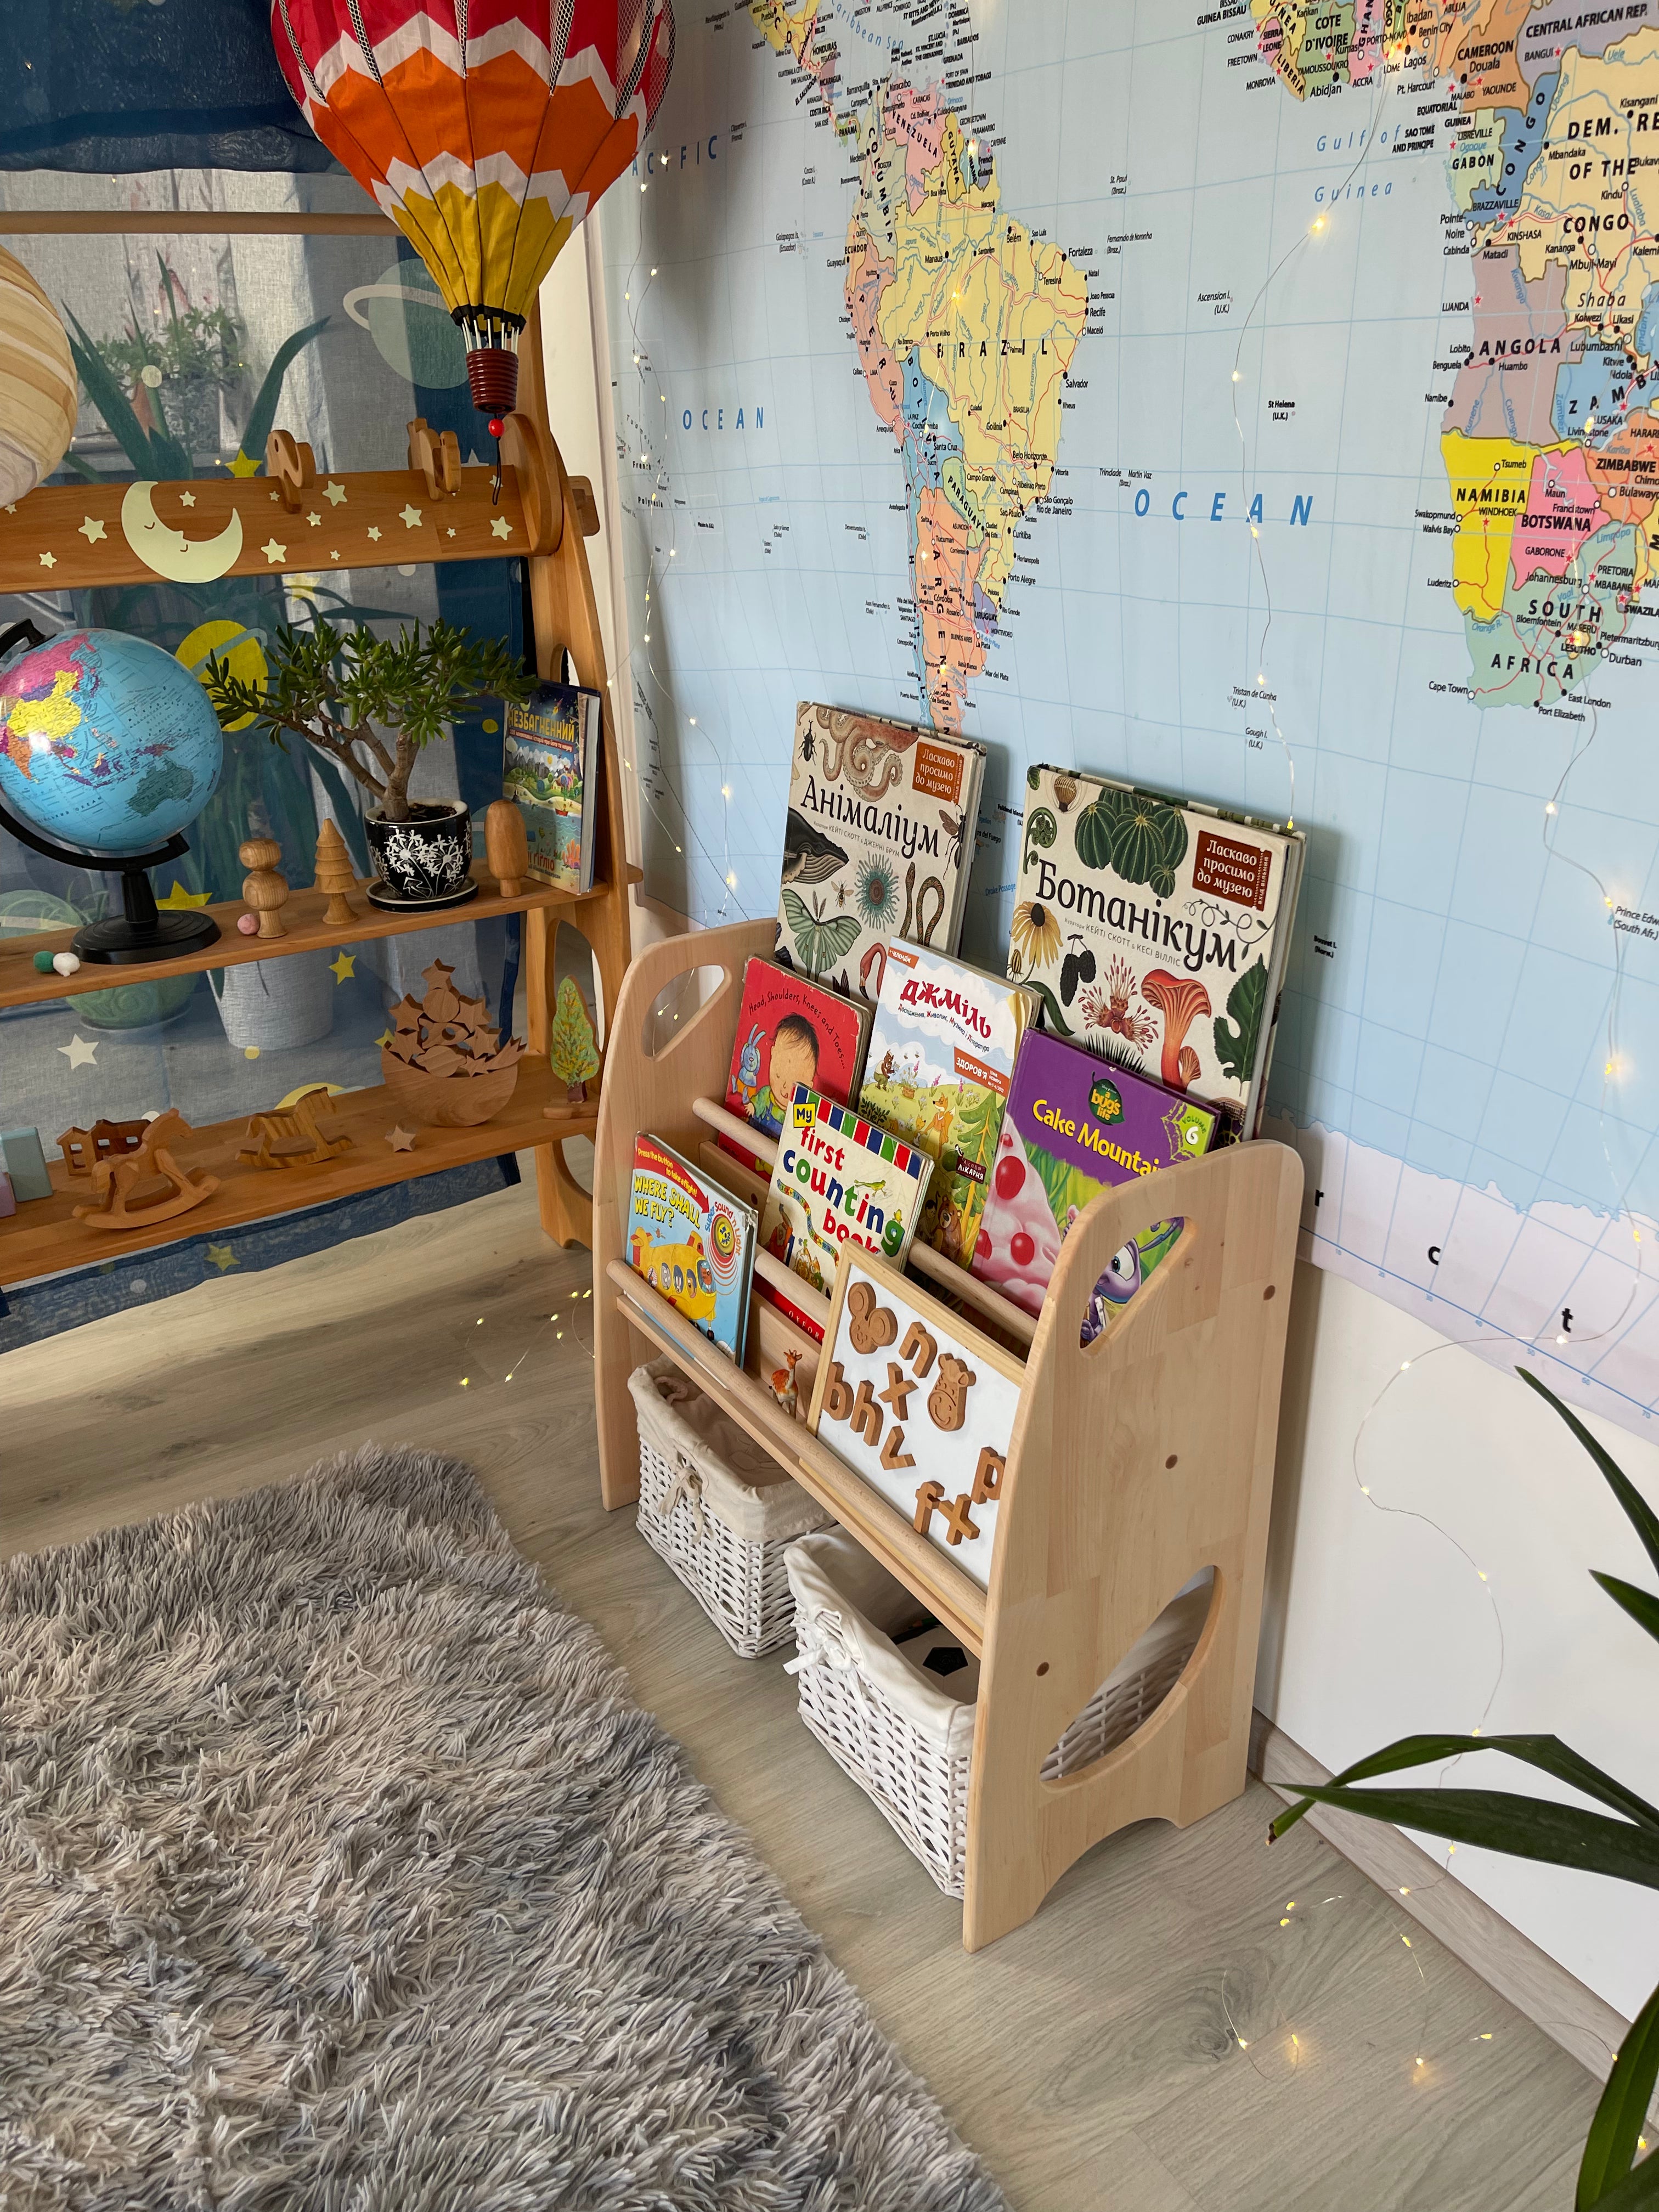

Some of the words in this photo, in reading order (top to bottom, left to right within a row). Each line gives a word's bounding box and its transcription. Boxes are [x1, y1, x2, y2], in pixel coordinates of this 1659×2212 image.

[1197, 12, 1221, 25] GUINEA
[1222, 5, 1246, 19] BISSAU
[1316, 14, 1342, 30] COTE
[1407, 9, 1432, 23] Ibadan
[1526, 18, 1572, 38] CENTRAL
[1575, 8, 1623, 29] AFRICAN
[1626, 3, 1648, 19] REP.
[1227, 30, 1255, 43] CONAKRY
[1263, 28, 1283, 40] SIERRA
[1419, 26, 1438, 37] Benin
[1440, 22, 1453, 34] City
[1263, 41, 1282, 52] LEONE
[1458, 40, 1514, 61] CAMEROON
[1227, 53, 1258, 67] FREETOWN
[1297, 60, 1348, 76] YAMOUSSOUKRO
[1404, 56, 1426, 69] Lagos
[1469, 58, 1500, 72] Douala
[1277, 54, 1304, 95] LIBERIA
[1352, 76, 1373, 88] ACCRA
[1246, 77, 1276, 91] MONROVIA
[1310, 84, 1341, 98] Abidjan
[1417, 101, 1457, 116] EQUATORIAL
[1444, 116, 1471, 128] GUINEA
[893, 111, 938, 157] VENEZUELA
[1316, 129, 1367, 152] Gulf
[1381, 125, 1402, 144] of
[1457, 128, 1493, 140] LIBREVILLE
[1497, 91, 1545, 196] CONGO
[1452, 154, 1494, 170] GABON
[1570, 162, 1592, 180] OF
[1601, 157, 1638, 177] THE
[1314, 182, 1392, 202] Guinea
[1472, 199, 1519, 212] BRAZZAVILLE
[1564, 214, 1629, 234] CONGO
[1507, 230, 1542, 241] KINSHASA
[845, 244, 867, 254] ECUADOR
[1069, 248, 1092, 257] Fortaleza
[1198, 292, 1227, 302] Ascension
[1577, 292, 1626, 307] Shaba
[1090, 308, 1105, 317] Recife
[1442, 302, 1469, 312] LUANDA
[937, 338, 1047, 358] BRAZIL
[1479, 338, 1560, 356] ANGOLA
[1570, 341, 1623, 352] Lubumbashi
[1065, 380, 1088, 388] Salvador
[683, 407, 764, 430] OCEAN
[1596, 458, 1656, 473] ZIMBABWE
[947, 475, 981, 529] PARAGUAY
[1457, 488, 1525, 504] NAMIBIA
[1135, 489, 1313, 526] OCEAN
[1479, 507, 1517, 517] WINDHOEK
[1521, 514, 1591, 532] BOTSWANA
[1525, 546, 1565, 557] GABORONE
[1598, 565, 1634, 577] PRETORIA
[1007, 574, 1021, 582] Porto
[1022, 576, 1035, 585] Alegre
[974, 611, 998, 622] URUGUAY
[1528, 599, 1602, 623] SOUTH
[1491, 654, 1573, 680] AFRICA
[1609, 653, 1642, 667] Durban
[1233, 686, 1250, 697] Tristan
[1260, 691, 1277, 701] Cunha
[1429, 681, 1447, 692] Cape
[1447, 684, 1468, 695] Town
[1538, 706, 1553, 716] Port
[1554, 709, 1585, 722] Elizabeth
[923, 749, 955, 768] Ласкаво
[920, 764, 953, 781] просимо
[916, 772, 924, 785] до
[926, 779, 951, 794] музею
[800, 775, 939, 859] Анімаліум
[829, 825, 843, 835] КЕЙТІ
[844, 831, 860, 842] СКОТТ
[864, 838, 884, 850] ДЖЕННІ
[886, 847, 900, 857] БРУМ
[1207, 840, 1257, 866] Ласкаво
[1204, 857, 1255, 882] просимо
[1197, 868, 1211, 884] до
[1214, 878, 1252, 898] музею
[1036, 858, 1237, 973] Ботанікум
[1086, 924, 1105, 937] КЕЙТІ
[1108, 933, 1131, 946] СКОТТ
[1137, 945, 1152, 956] КЕСІ
[1155, 951, 1181, 967] ВІЛЛІС
[749, 995, 766, 1015] Head,
[768, 988, 800, 1005] Shoulders,
[803, 994, 821, 1018] Knees
[821, 1018, 834, 1035] and
[796, 1108, 813, 1123] My
[1032, 1099, 1075, 1137] Cake
[1097, 1106, 1110, 1120] life
[1181, 1115, 1207, 1133] VOLUME
[1186, 1126, 1199, 1144] 6
[800, 1126, 845, 1171] first
[638, 1148, 650, 1159] Press
[657, 1154, 673, 1167] button
[666, 1167, 671, 1176] to
[671, 1171, 680, 1183] take
[684, 1180, 698, 1197] flight!
[635, 1174, 667, 1201] WHERE
[669, 1188, 701, 1230] SHALL
[783, 1150, 905, 1257] counting
[635, 1196, 649, 1216] WE
[650, 1201, 675, 1228] FLY?
